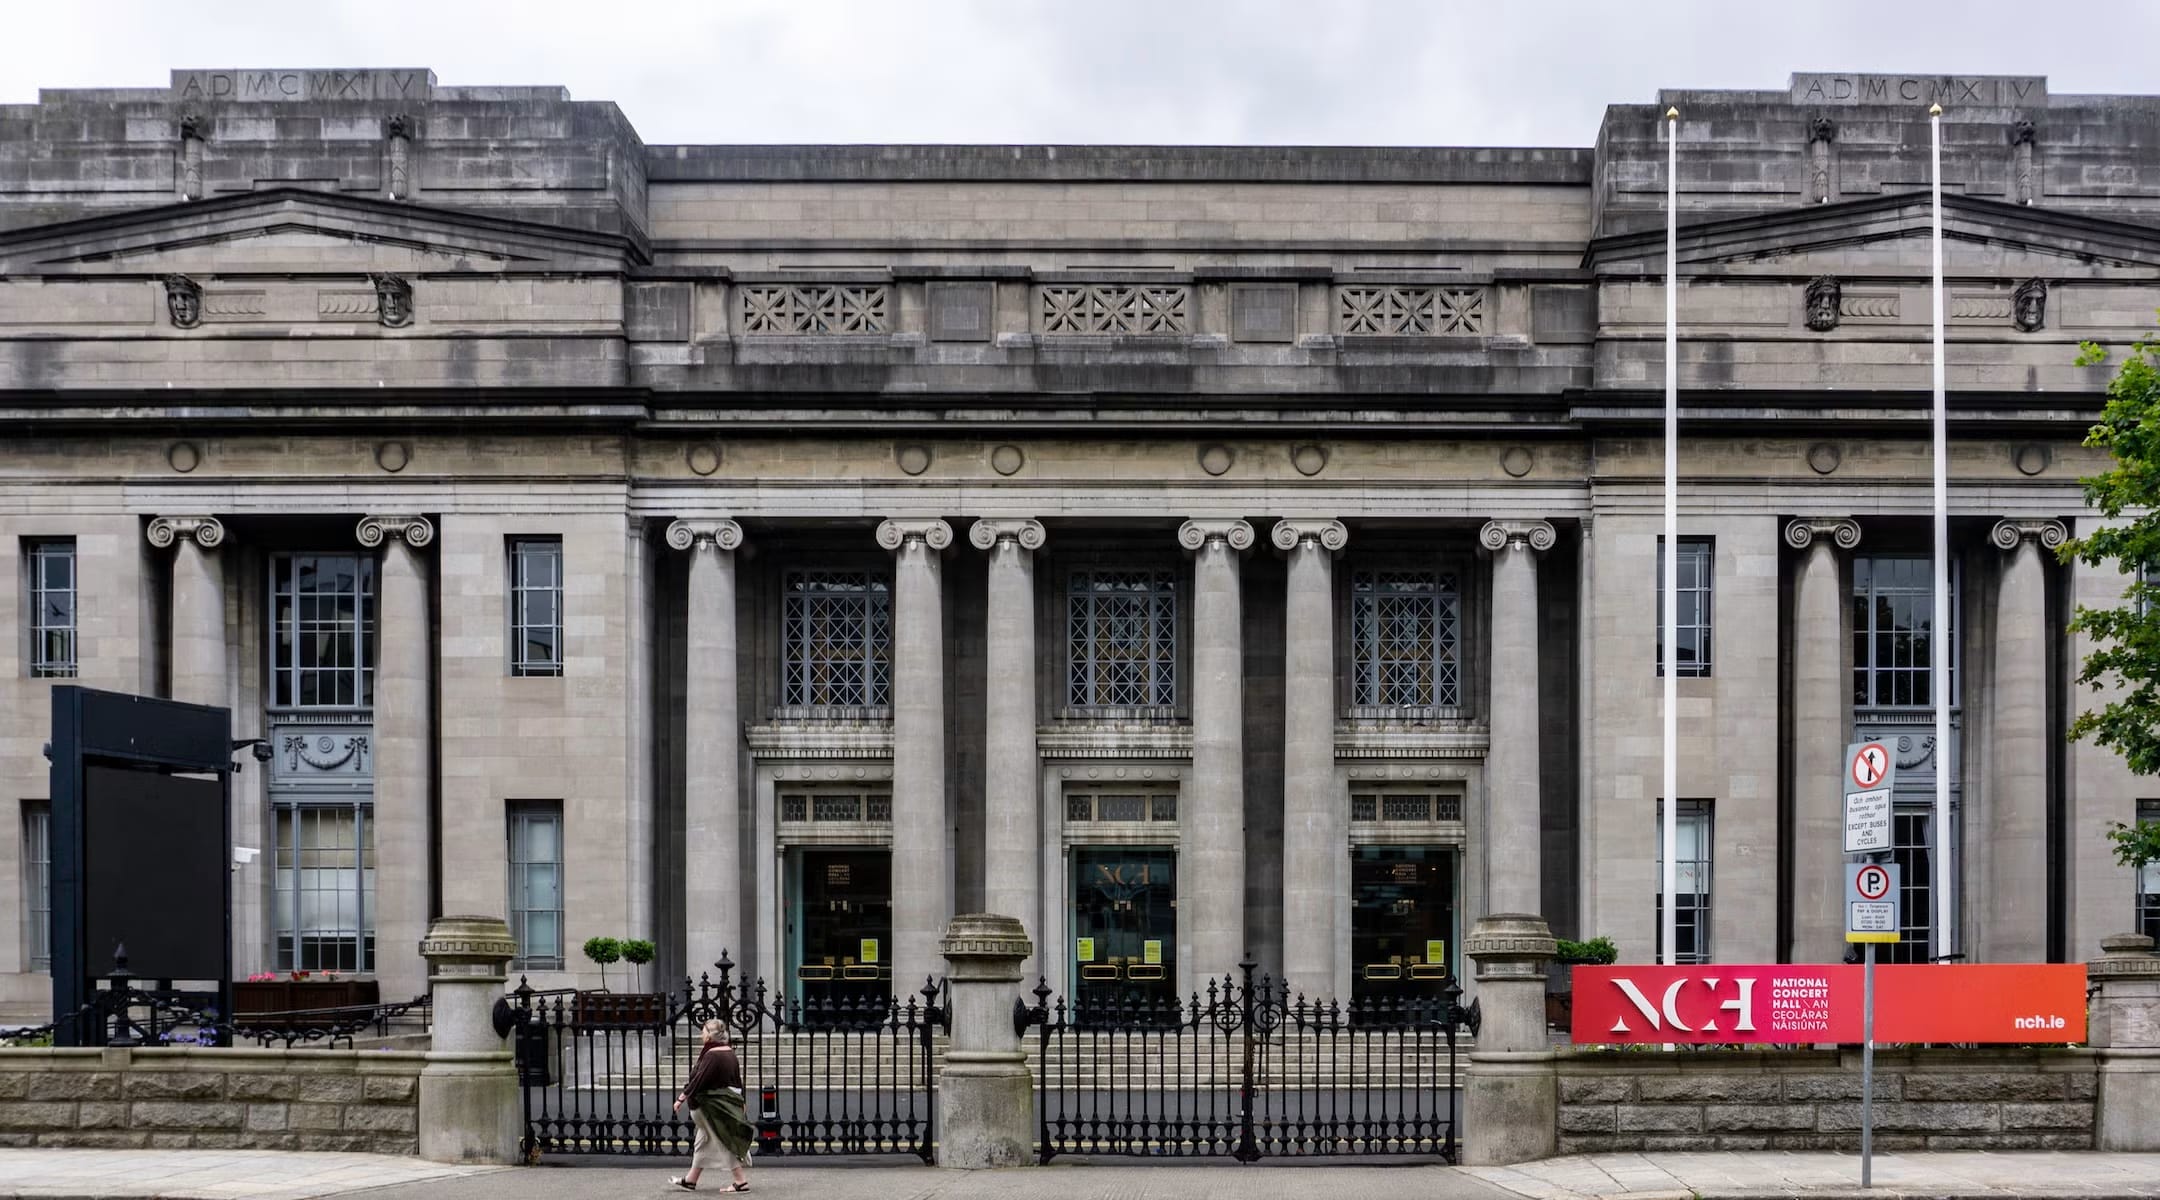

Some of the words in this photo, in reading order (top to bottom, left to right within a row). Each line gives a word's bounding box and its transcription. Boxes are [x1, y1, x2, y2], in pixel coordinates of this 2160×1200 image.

[1848, 822, 1867, 831] EXCEPT
[1869, 820, 1887, 828] BUSES
[1857, 837, 1877, 845] CYCLES
[1867, 872, 1880, 893] P
[1772, 978, 1828, 987] NATIONAL
[1772, 988, 1828, 998] CONCERT
[1610, 978, 1758, 1032] NCH
[1772, 999, 1801, 1009] HALL
[1813, 999, 1828, 1008] AN
[1772, 1008, 1828, 1020] CEOLÁRAS
[1772, 1019, 1828, 1030] NÁISIÚNTA
[2015, 1015, 2065, 1029] nch.ie
